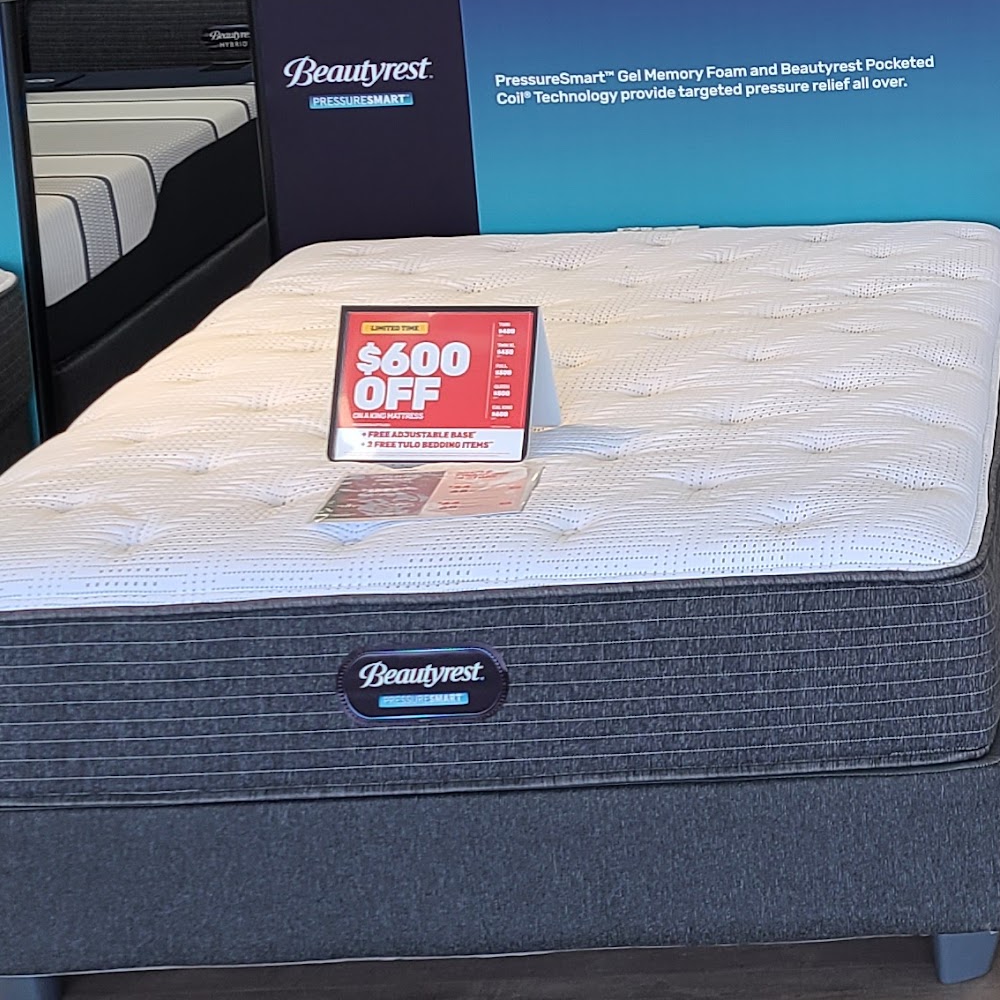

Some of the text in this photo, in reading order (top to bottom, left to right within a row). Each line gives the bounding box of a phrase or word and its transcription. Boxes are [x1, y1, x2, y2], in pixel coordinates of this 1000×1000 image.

[283, 56, 434, 88] Beautyrest
[617, 68, 642, 82] Gel
[644, 68, 704, 82] Memory
[706, 66, 747, 79] Foam
[750, 63, 778, 77] and
[781, 58, 863, 76] Beautyrest
[865, 55, 934, 71] Pocketed
[533, 89, 618, 104] Technology
[621, 86, 676, 103] provide
[678, 82, 742, 100] targeted
[745, 80, 809, 97] pressure
[812, 77, 850, 92] relief
[852, 76, 869, 90] all
[872, 78, 908, 88] over.
[356, 341, 471, 376] $600
[354, 376, 442, 411] OFF
[358, 660, 486, 688] Beautyrest
